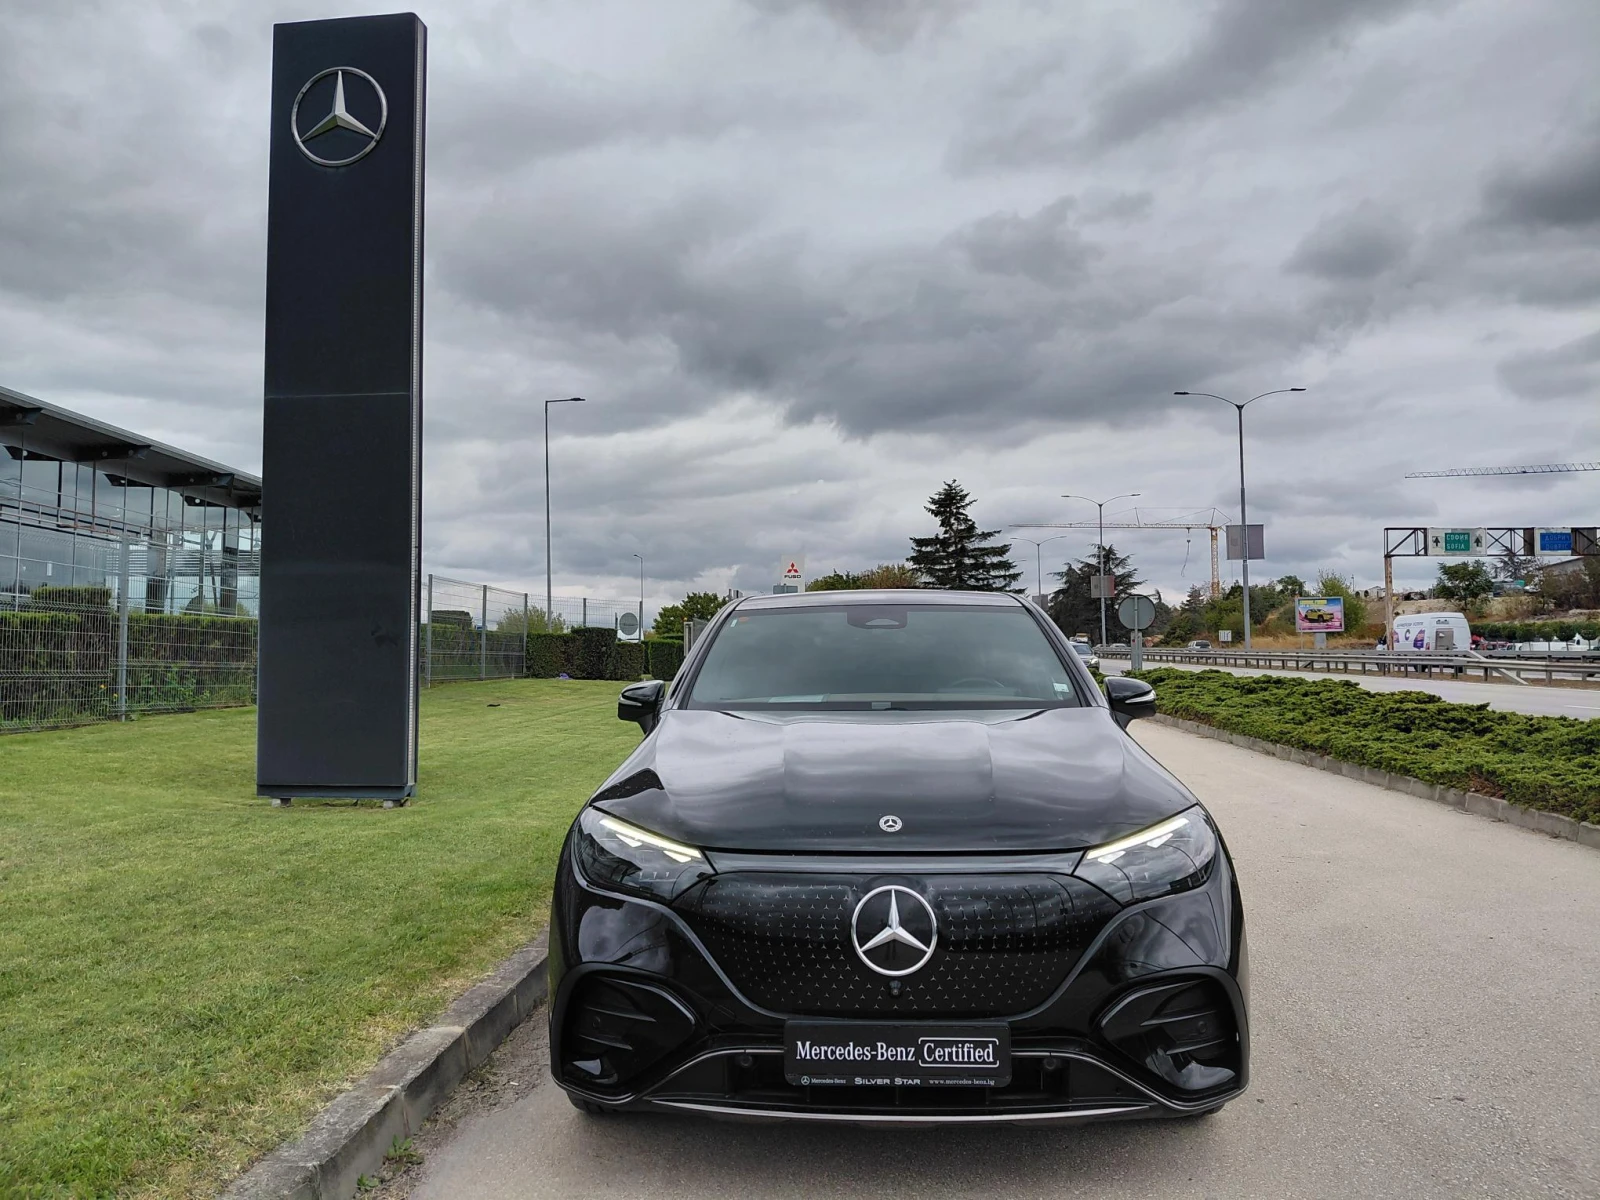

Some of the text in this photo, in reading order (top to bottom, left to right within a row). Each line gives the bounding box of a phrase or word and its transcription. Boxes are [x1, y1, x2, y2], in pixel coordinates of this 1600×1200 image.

[796, 1041, 994, 1063] Mercedes-Benz Certified
[854, 1077, 921, 1085] SILVER STAR
[928, 1078, 995, 1086] www.mercedes-benz.bg
